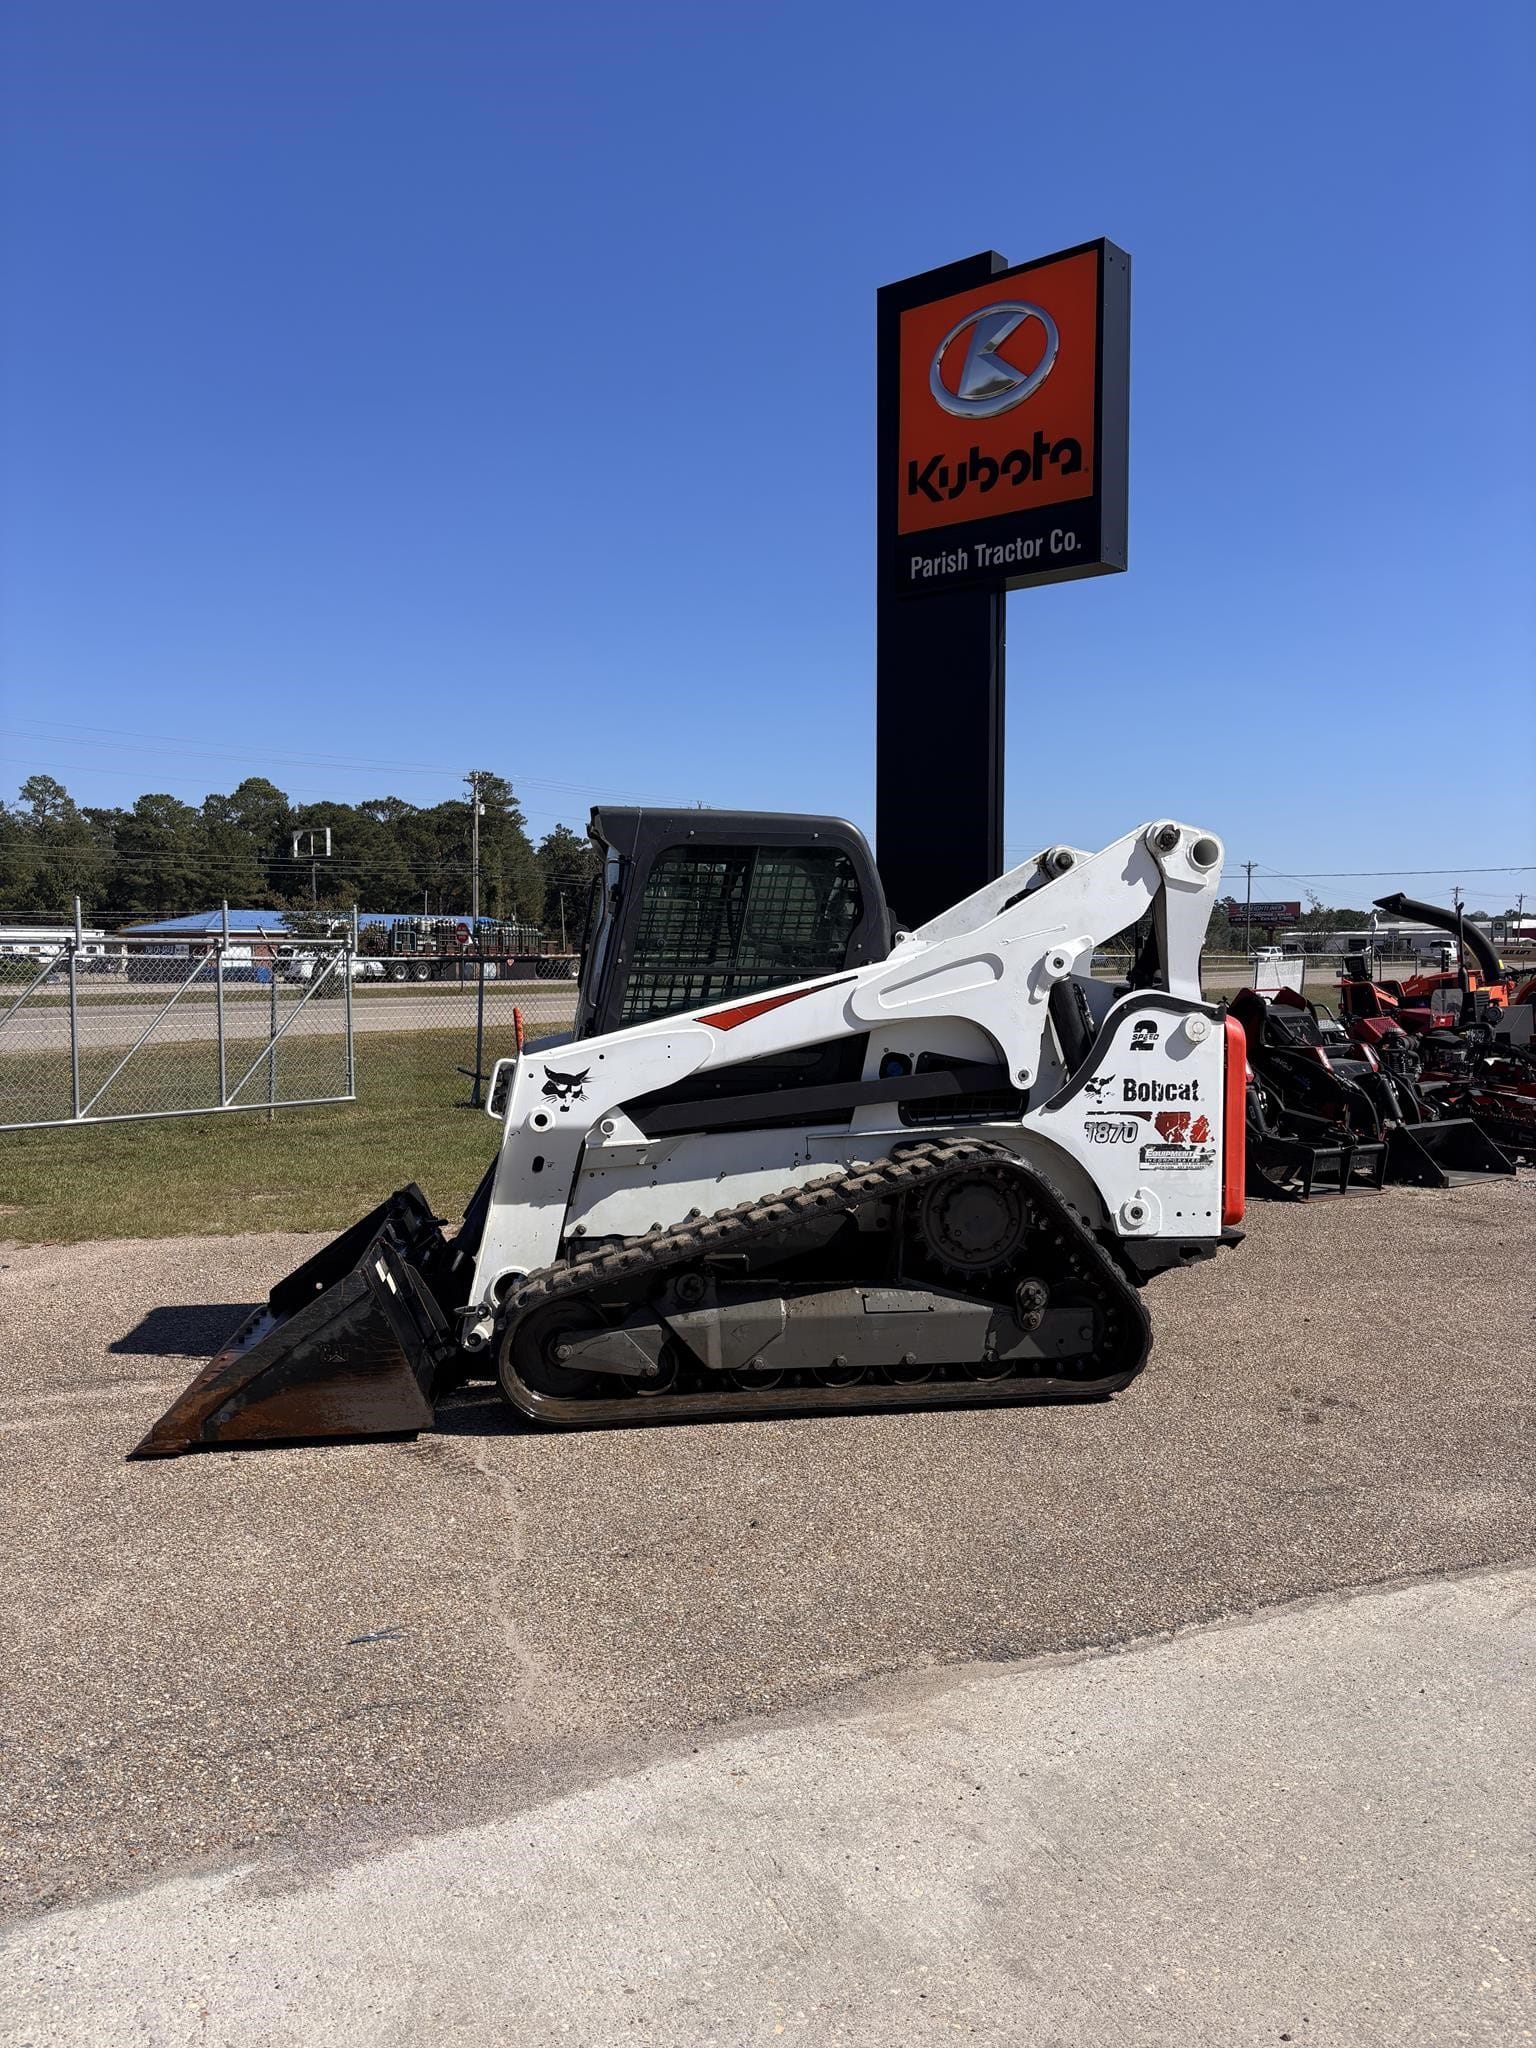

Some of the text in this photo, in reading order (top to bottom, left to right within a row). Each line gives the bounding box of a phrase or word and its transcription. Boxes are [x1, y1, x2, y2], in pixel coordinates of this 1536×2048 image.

[908, 431, 1083, 503] Kubota
[911, 528, 1082, 580] Parish Tractor Co.
[1123, 1078, 1199, 1102] Bobcat
